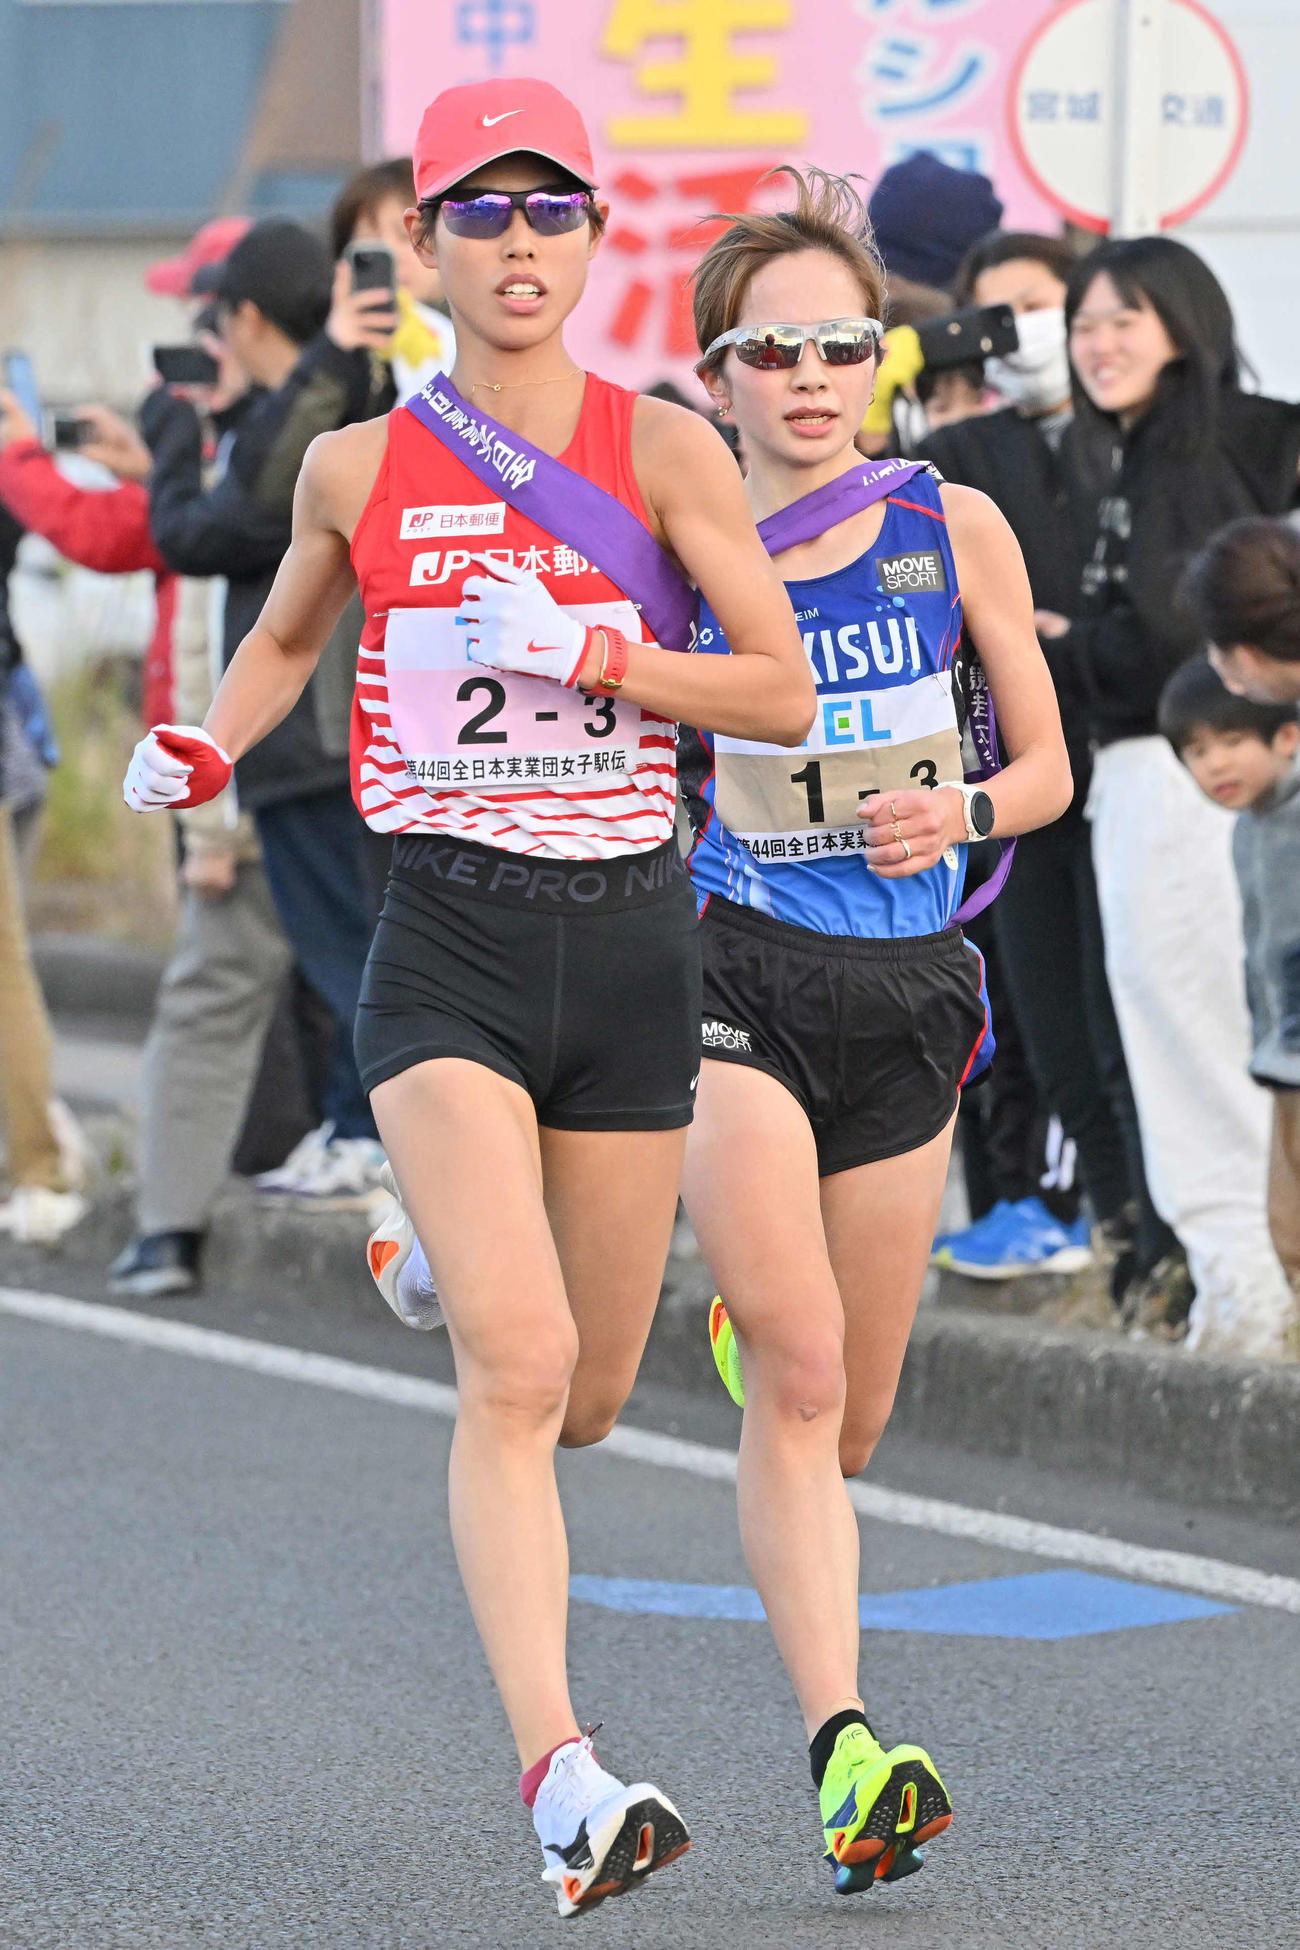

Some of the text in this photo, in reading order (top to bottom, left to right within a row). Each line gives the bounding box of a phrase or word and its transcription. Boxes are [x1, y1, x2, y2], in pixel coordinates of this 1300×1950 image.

[440, 512, 500, 529] 日本郵便
[485, 545, 601, 577] 日本郵
[882, 556, 937, 577] MOVE
[886, 571, 938, 590] SPORT
[800, 699, 892, 747] EL
[489, 861, 608, 903] PRO
[701, 1021, 750, 1042] MOVE
